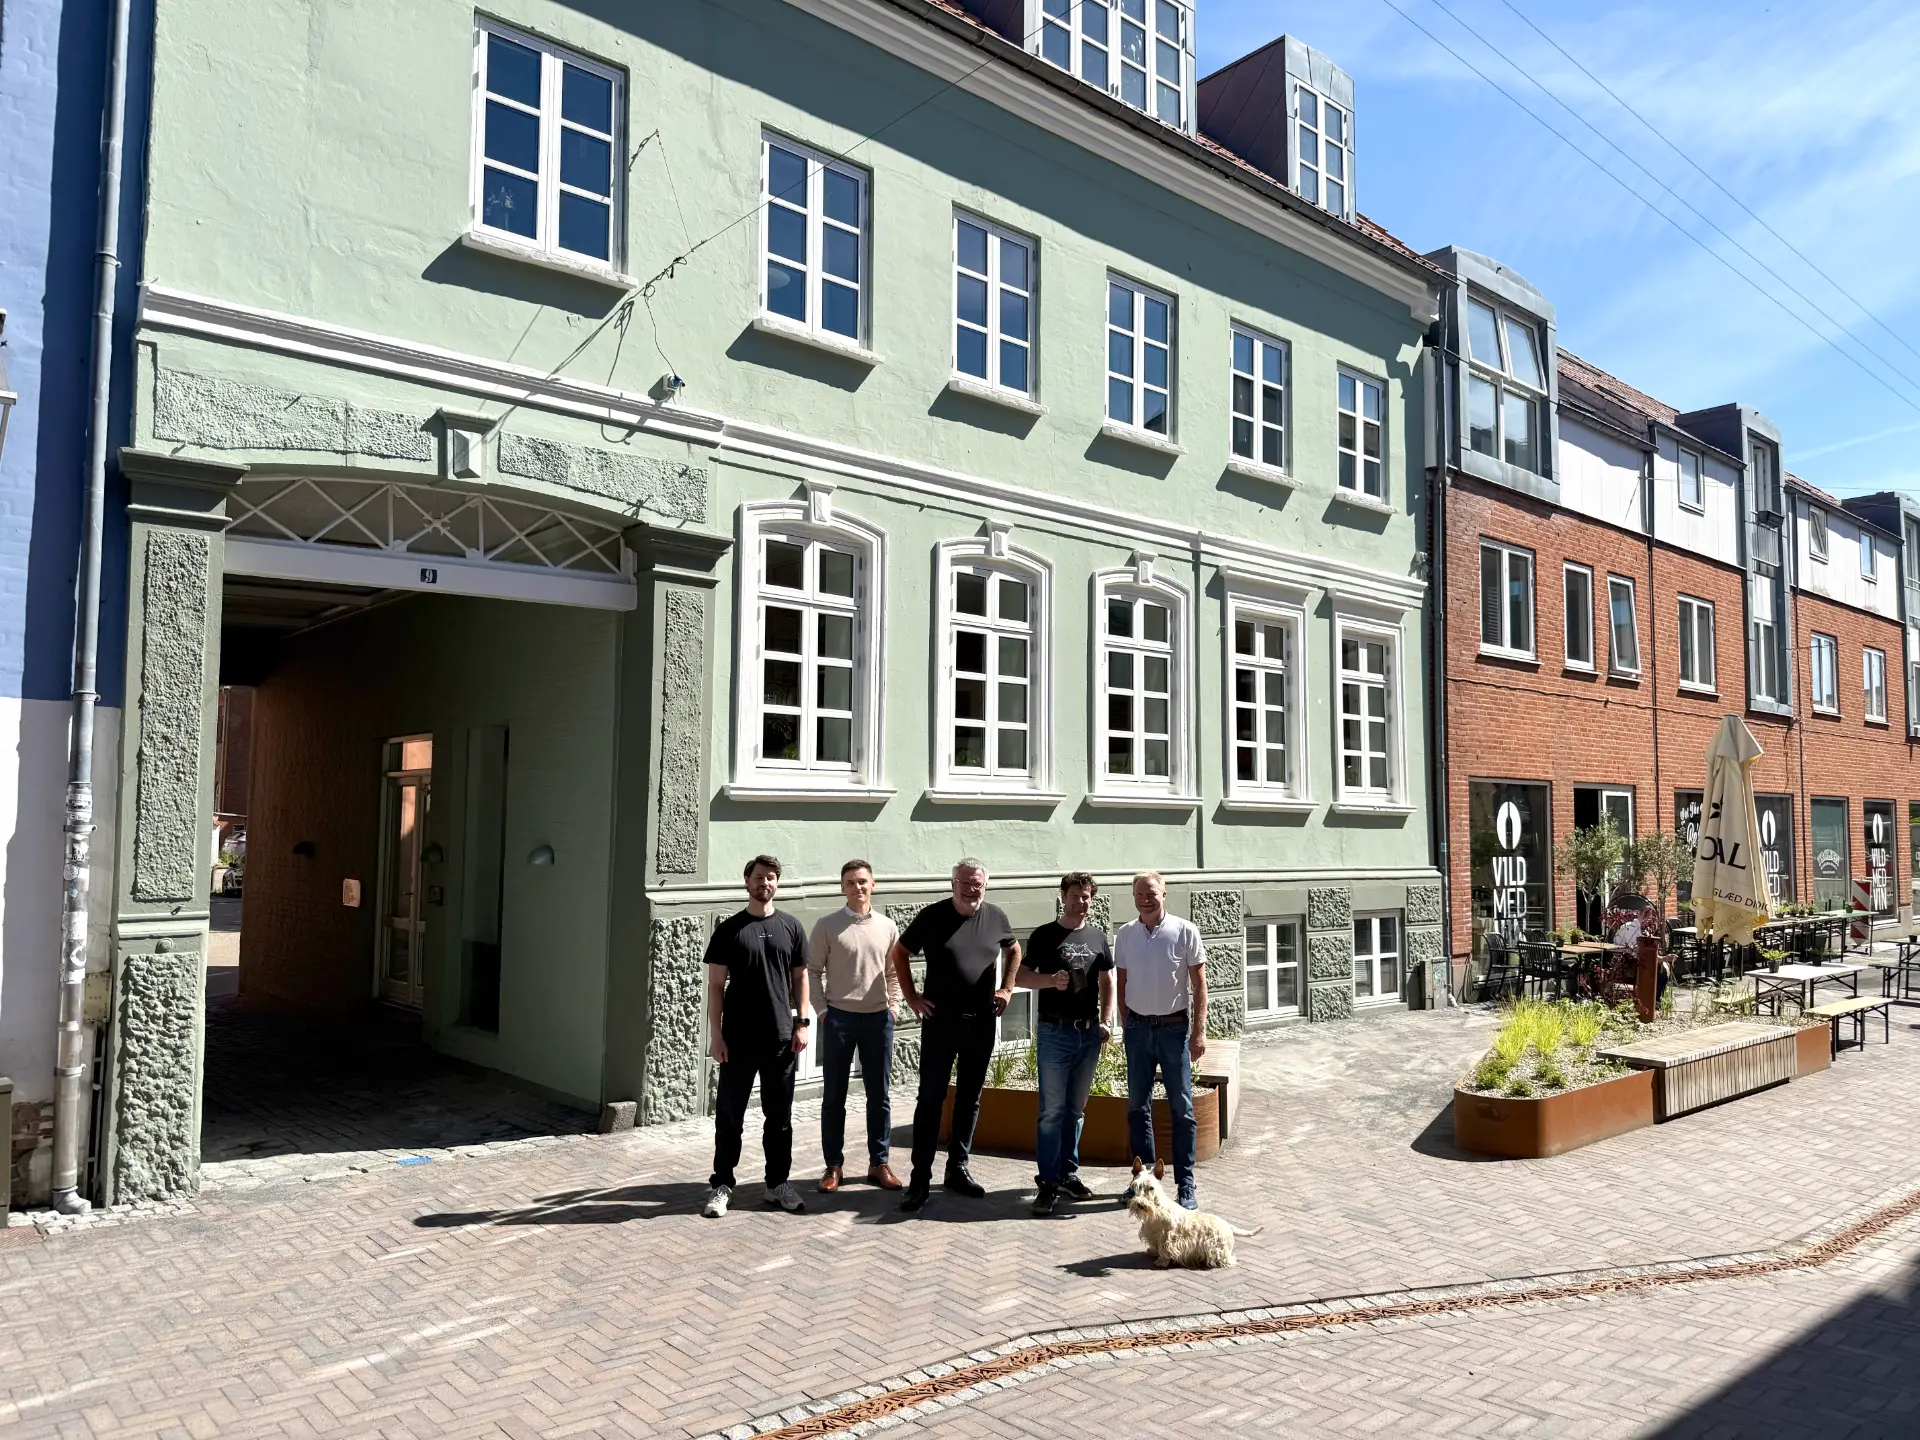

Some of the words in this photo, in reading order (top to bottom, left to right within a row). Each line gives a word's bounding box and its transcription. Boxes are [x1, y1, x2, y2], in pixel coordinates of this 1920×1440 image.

[425, 569, 433, 583] 9
[1872, 848, 1886, 867] VILD
[1768, 874, 1780, 896] ED
[1873, 868, 1887, 888] MED
[1494, 888, 1527, 919] MED
[1712, 887, 1743, 903] GLÆD
[1873, 888, 1888, 910] VIN
